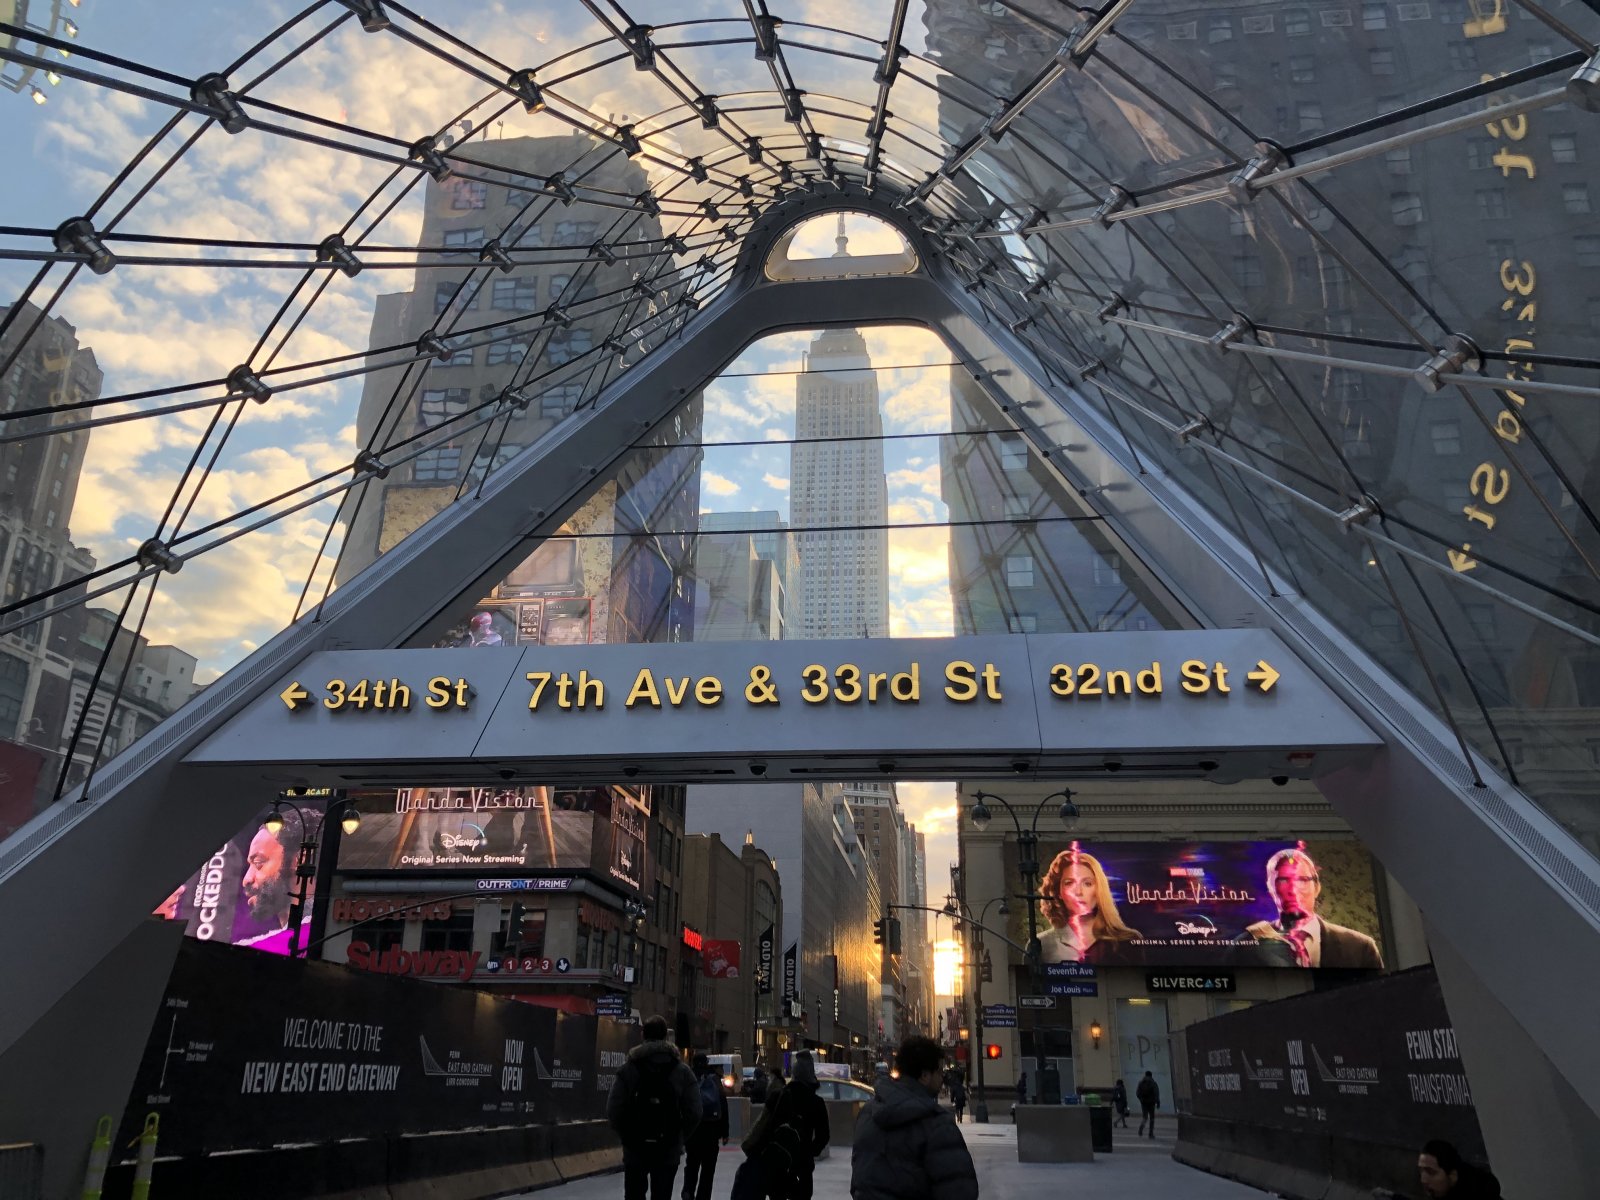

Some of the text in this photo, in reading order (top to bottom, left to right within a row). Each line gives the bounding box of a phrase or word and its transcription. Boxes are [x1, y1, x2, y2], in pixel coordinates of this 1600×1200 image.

[322, 659, 1231, 710] 34th St 7th Ave & 33rd St 32nd St
[287, 788, 331, 796] SILRCAST
[401, 854, 525, 866] Original Series Now Streaming
[538, 879, 567, 888] PRIME
[347, 940, 481, 981] Subway
[761, 940, 771, 960] OLD
[785, 958, 795, 976] OLD
[1047, 966, 1094, 976] Seventh Ave
[1051, 986, 1062, 994] Joe
[1063, 986, 1081, 994] Louis
[1152, 977, 1230, 989] SILVERCAST
[283, 1017, 383, 1052] WELCOME TO THE
[1406, 1030, 1434, 1060] PENN
[504, 1039, 524, 1064] NOW
[1286, 1040, 1304, 1066] NOW
[240, 1061, 401, 1094] NEW EAST END GATEWAY
[447, 1061, 493, 1074] EAST END GATEWAY
[501, 1065, 523, 1092] OPEN
[1290, 1068, 1310, 1096] OPEN
